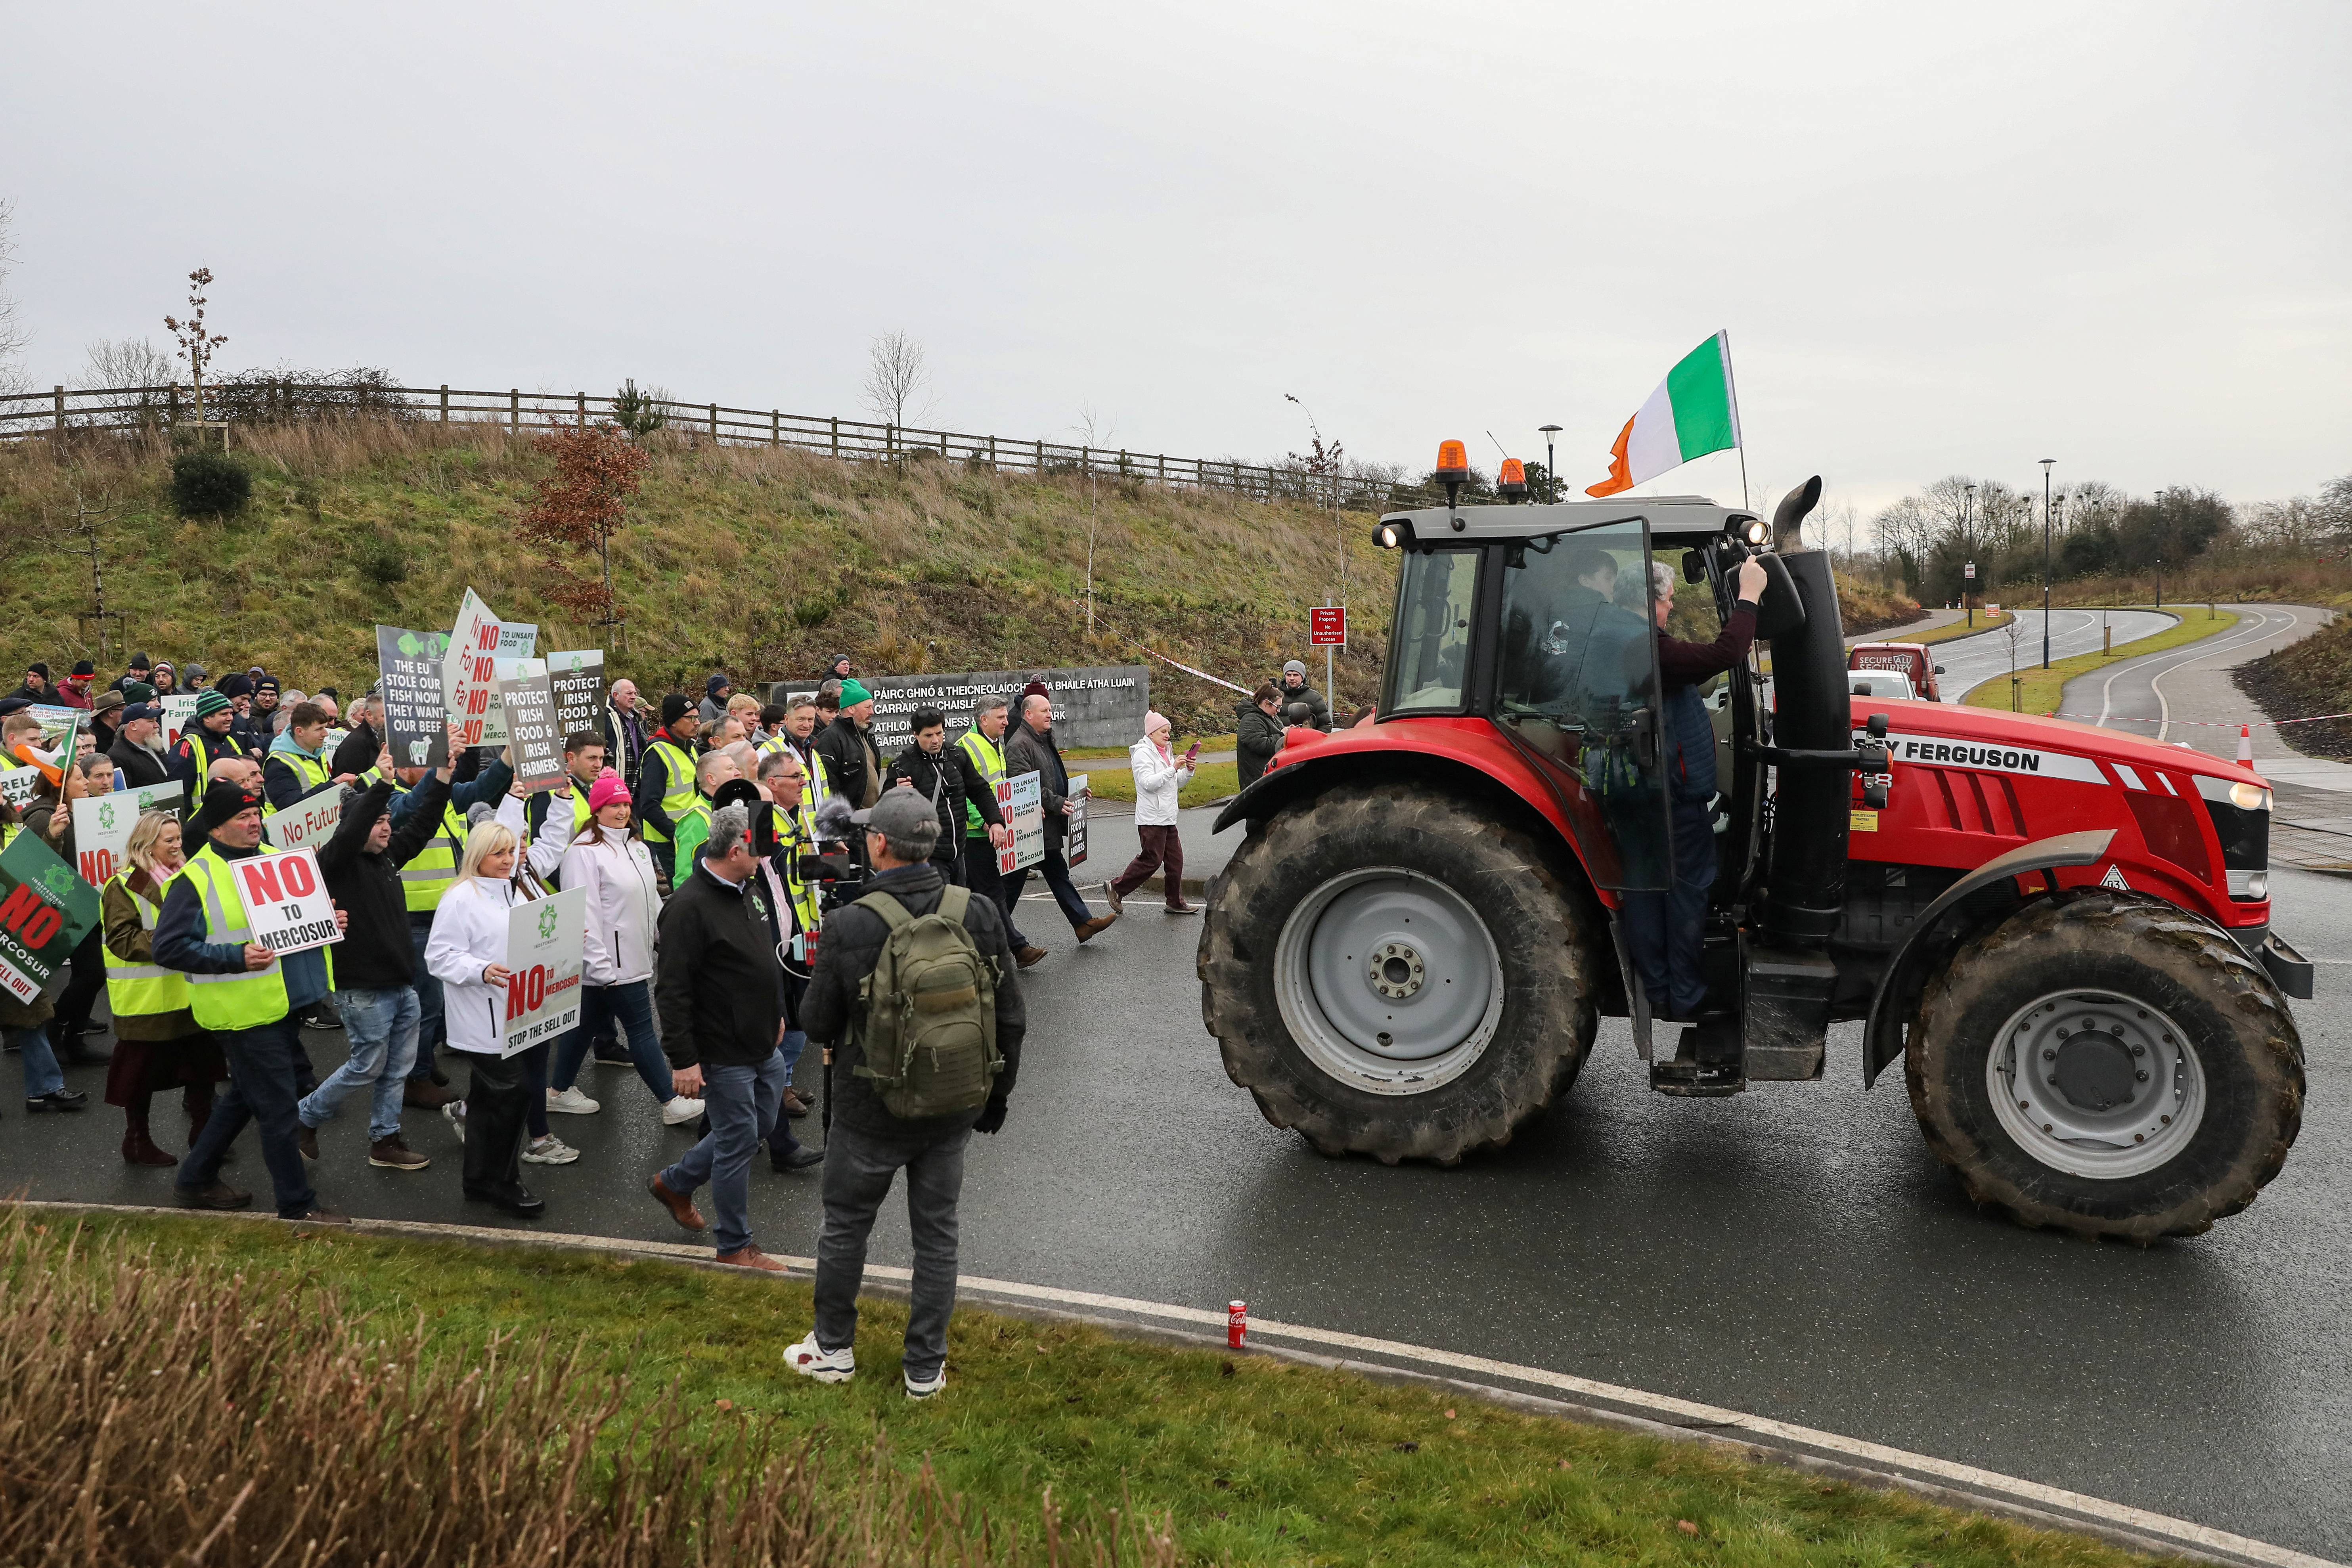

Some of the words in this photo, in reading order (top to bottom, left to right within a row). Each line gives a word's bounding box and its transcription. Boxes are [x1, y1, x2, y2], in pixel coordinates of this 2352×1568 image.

[478, 625, 499, 650] NO
[394, 660, 414, 673] THE
[417, 662, 430, 674] EU
[473, 657, 493, 682] NO
[1860, 664, 1913, 673] SECURITY
[386, 673, 417, 688] STOLE
[419, 677, 441, 690] OUR
[554, 677, 601, 692] PROTECT
[874, 686, 904, 700] PÁIRC
[907, 685, 935, 698] GHNÓ
[938, 686, 944, 696] &
[946, 681, 1031, 696] THEICNEOLAÍOCH
[1056, 679, 1085, 690] BHAILE
[1087, 677, 1109, 689] ÁTHA
[1111, 677, 1135, 687] LUAIN
[389, 689, 412, 702] FISH
[415, 691, 440, 704] NOW
[467, 689, 488, 714] NO
[505, 690, 549, 706] PROTECT
[564, 692, 591, 705] IRISH
[387, 704, 413, 717] THEY
[415, 706, 444, 718] WANT
[558, 706, 588, 720] FOOD
[591, 705, 598, 716] &
[874, 702, 919, 714] CARRAIG
[937, 697, 981, 710] CHAISLE
[517, 708, 544, 723] IRISH
[875, 721, 911, 732] ATHLON
[945, 717, 966, 727] NESS
[1051, 710, 1066, 721] ARK
[393, 719, 417, 732] OUR
[419, 720, 441, 732] BEEF
[464, 719, 483, 744] NO
[515, 726, 543, 741] FOOD
[545, 724, 553, 738] &
[565, 719, 592, 734] IRISH
[329, 732, 344, 741] Irish
[876, 735, 915, 747] GARRYC
[524, 742, 551, 758] IRISH
[1905, 742, 2040, 771] FERGUSON
[521, 758, 559, 777] FARMERS
[1, 774, 38, 791] RELA
[997, 781, 1011, 803] NO
[1021, 776, 1038, 786] UNSAFE
[9, 789, 33, 802] SA
[1015, 808, 1034, 818] PRICING
[1022, 800, 1039, 809] UNFAIR
[1073, 809, 1083, 821] IRISH
[283, 822, 302, 847] No
[1016, 828, 1043, 842] HORMONES
[1071, 822, 1081, 834] FOOD
[1082, 820, 1085, 828] &
[1073, 831, 1083, 844] IRISH
[1018, 850, 1043, 864] MERCOSUR
[1070, 841, 1085, 857] FARMERS
[80, 848, 112, 887] NO
[112, 854, 118, 863] TO
[1001, 851, 1016, 873] NO
[241, 856, 316, 906] NO
[32, 877, 66, 906] INDEPENDENT
[35, 886, 56, 904] IRELAND
[0, 882, 62, 949] NO
[281, 904, 302, 921] TO
[260, 919, 337, 951] MERCOSUR
[0, 931, 50, 979] RCOSUR
[11, 977, 32, 996] OUT
[507, 964, 545, 1021] NO
[546, 968, 554, 980] TO
[545, 974, 579, 996] MERCOSUR
[508, 1030, 527, 1048] STOP
[529, 1024, 543, 1040] THE
[544, 1016, 560, 1033] SELL
[563, 1010, 576, 1025] OUT
